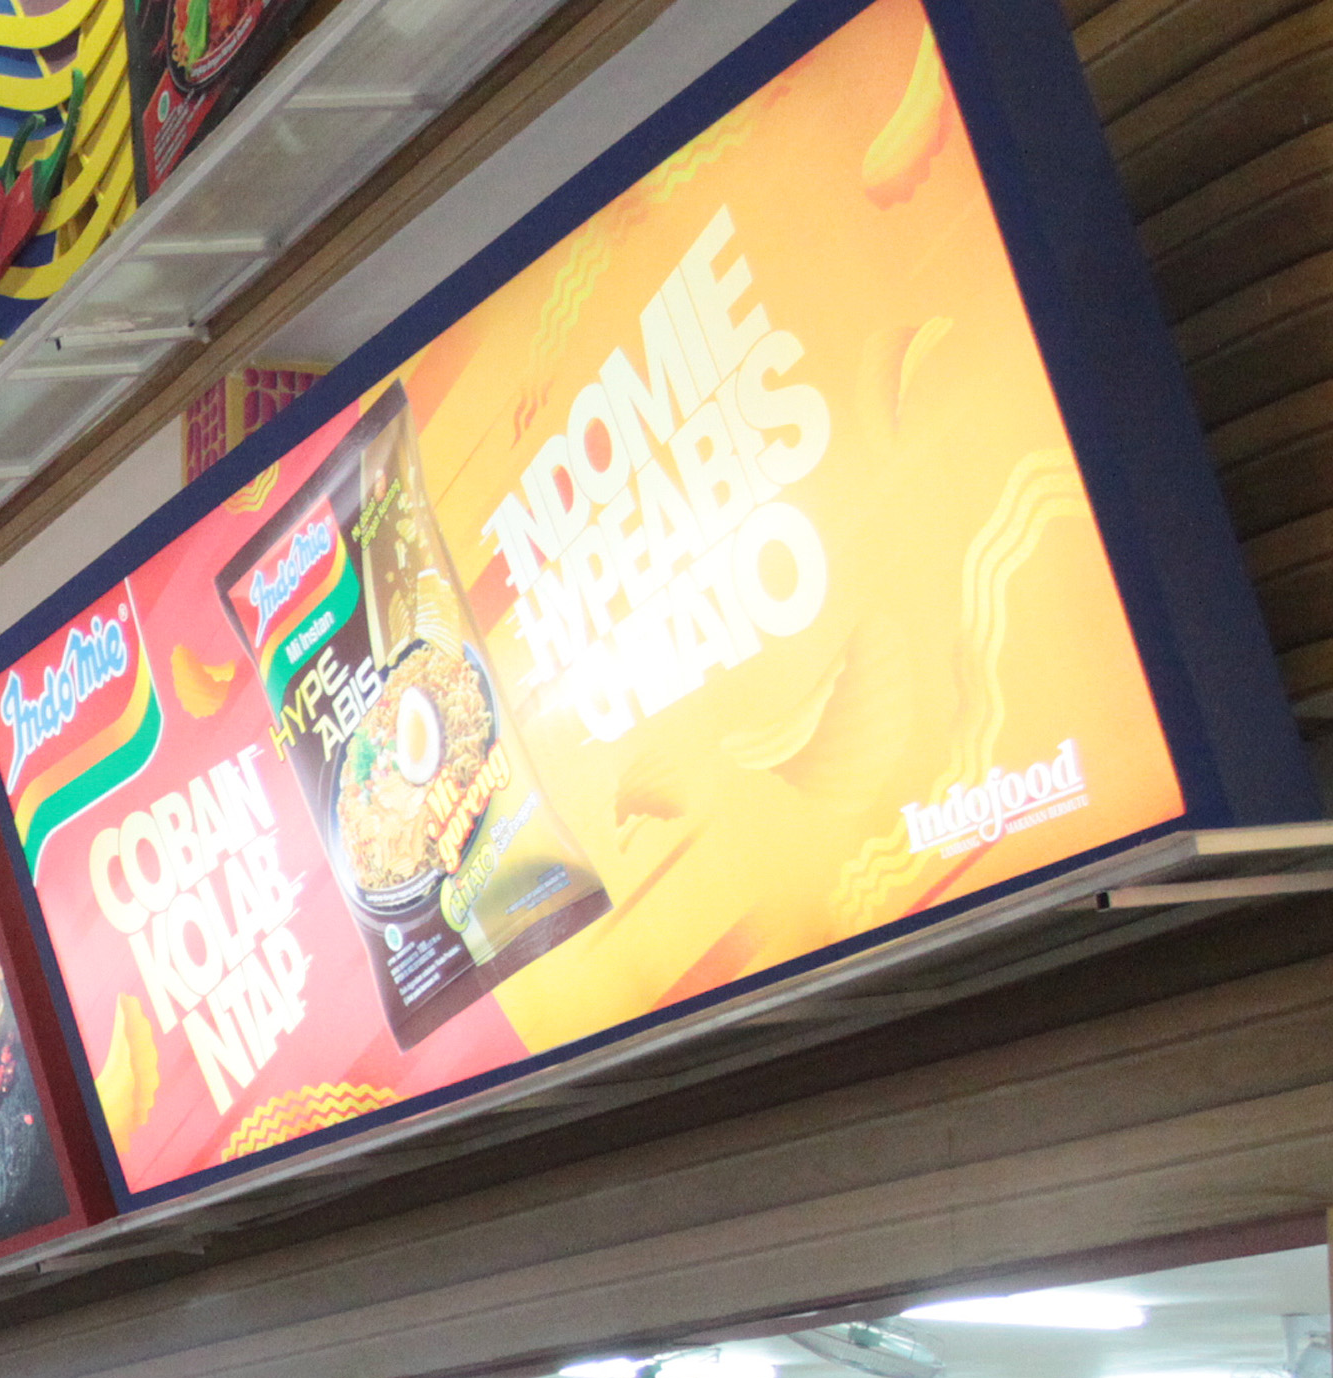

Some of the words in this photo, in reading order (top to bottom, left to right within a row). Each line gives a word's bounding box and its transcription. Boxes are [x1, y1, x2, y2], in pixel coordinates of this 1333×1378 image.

[481, 204, 771, 588] INDOMIE
[515, 330, 831, 690] HYPEABIS
[1, 611, 129, 796] Indomie
[269, 646, 351, 762] HYPE
[313, 656, 385, 763] ABIS
[438, 737, 512, 874] goreng
[900, 738, 1086, 854] Indofood
